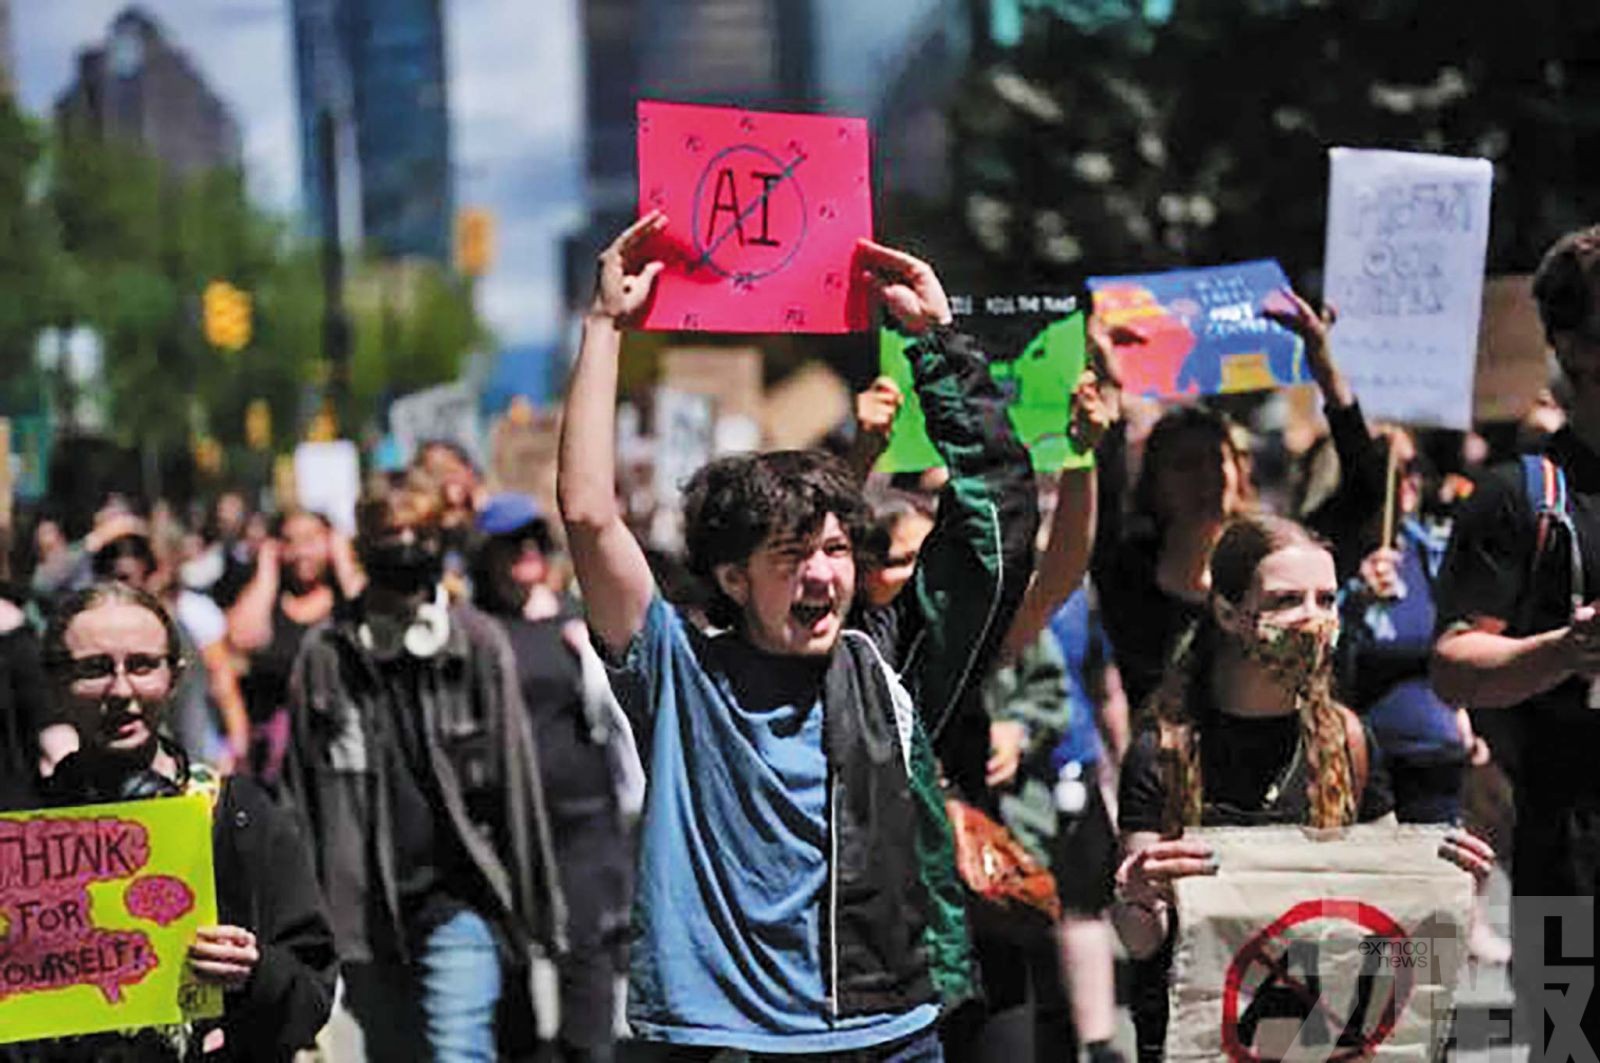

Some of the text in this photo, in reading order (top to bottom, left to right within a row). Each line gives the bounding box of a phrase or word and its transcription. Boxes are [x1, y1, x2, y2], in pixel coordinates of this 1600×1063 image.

[705, 168, 780, 248] AI
[17, 901, 83, 939] FOR
[0, 939, 143, 985] OURSELF!
